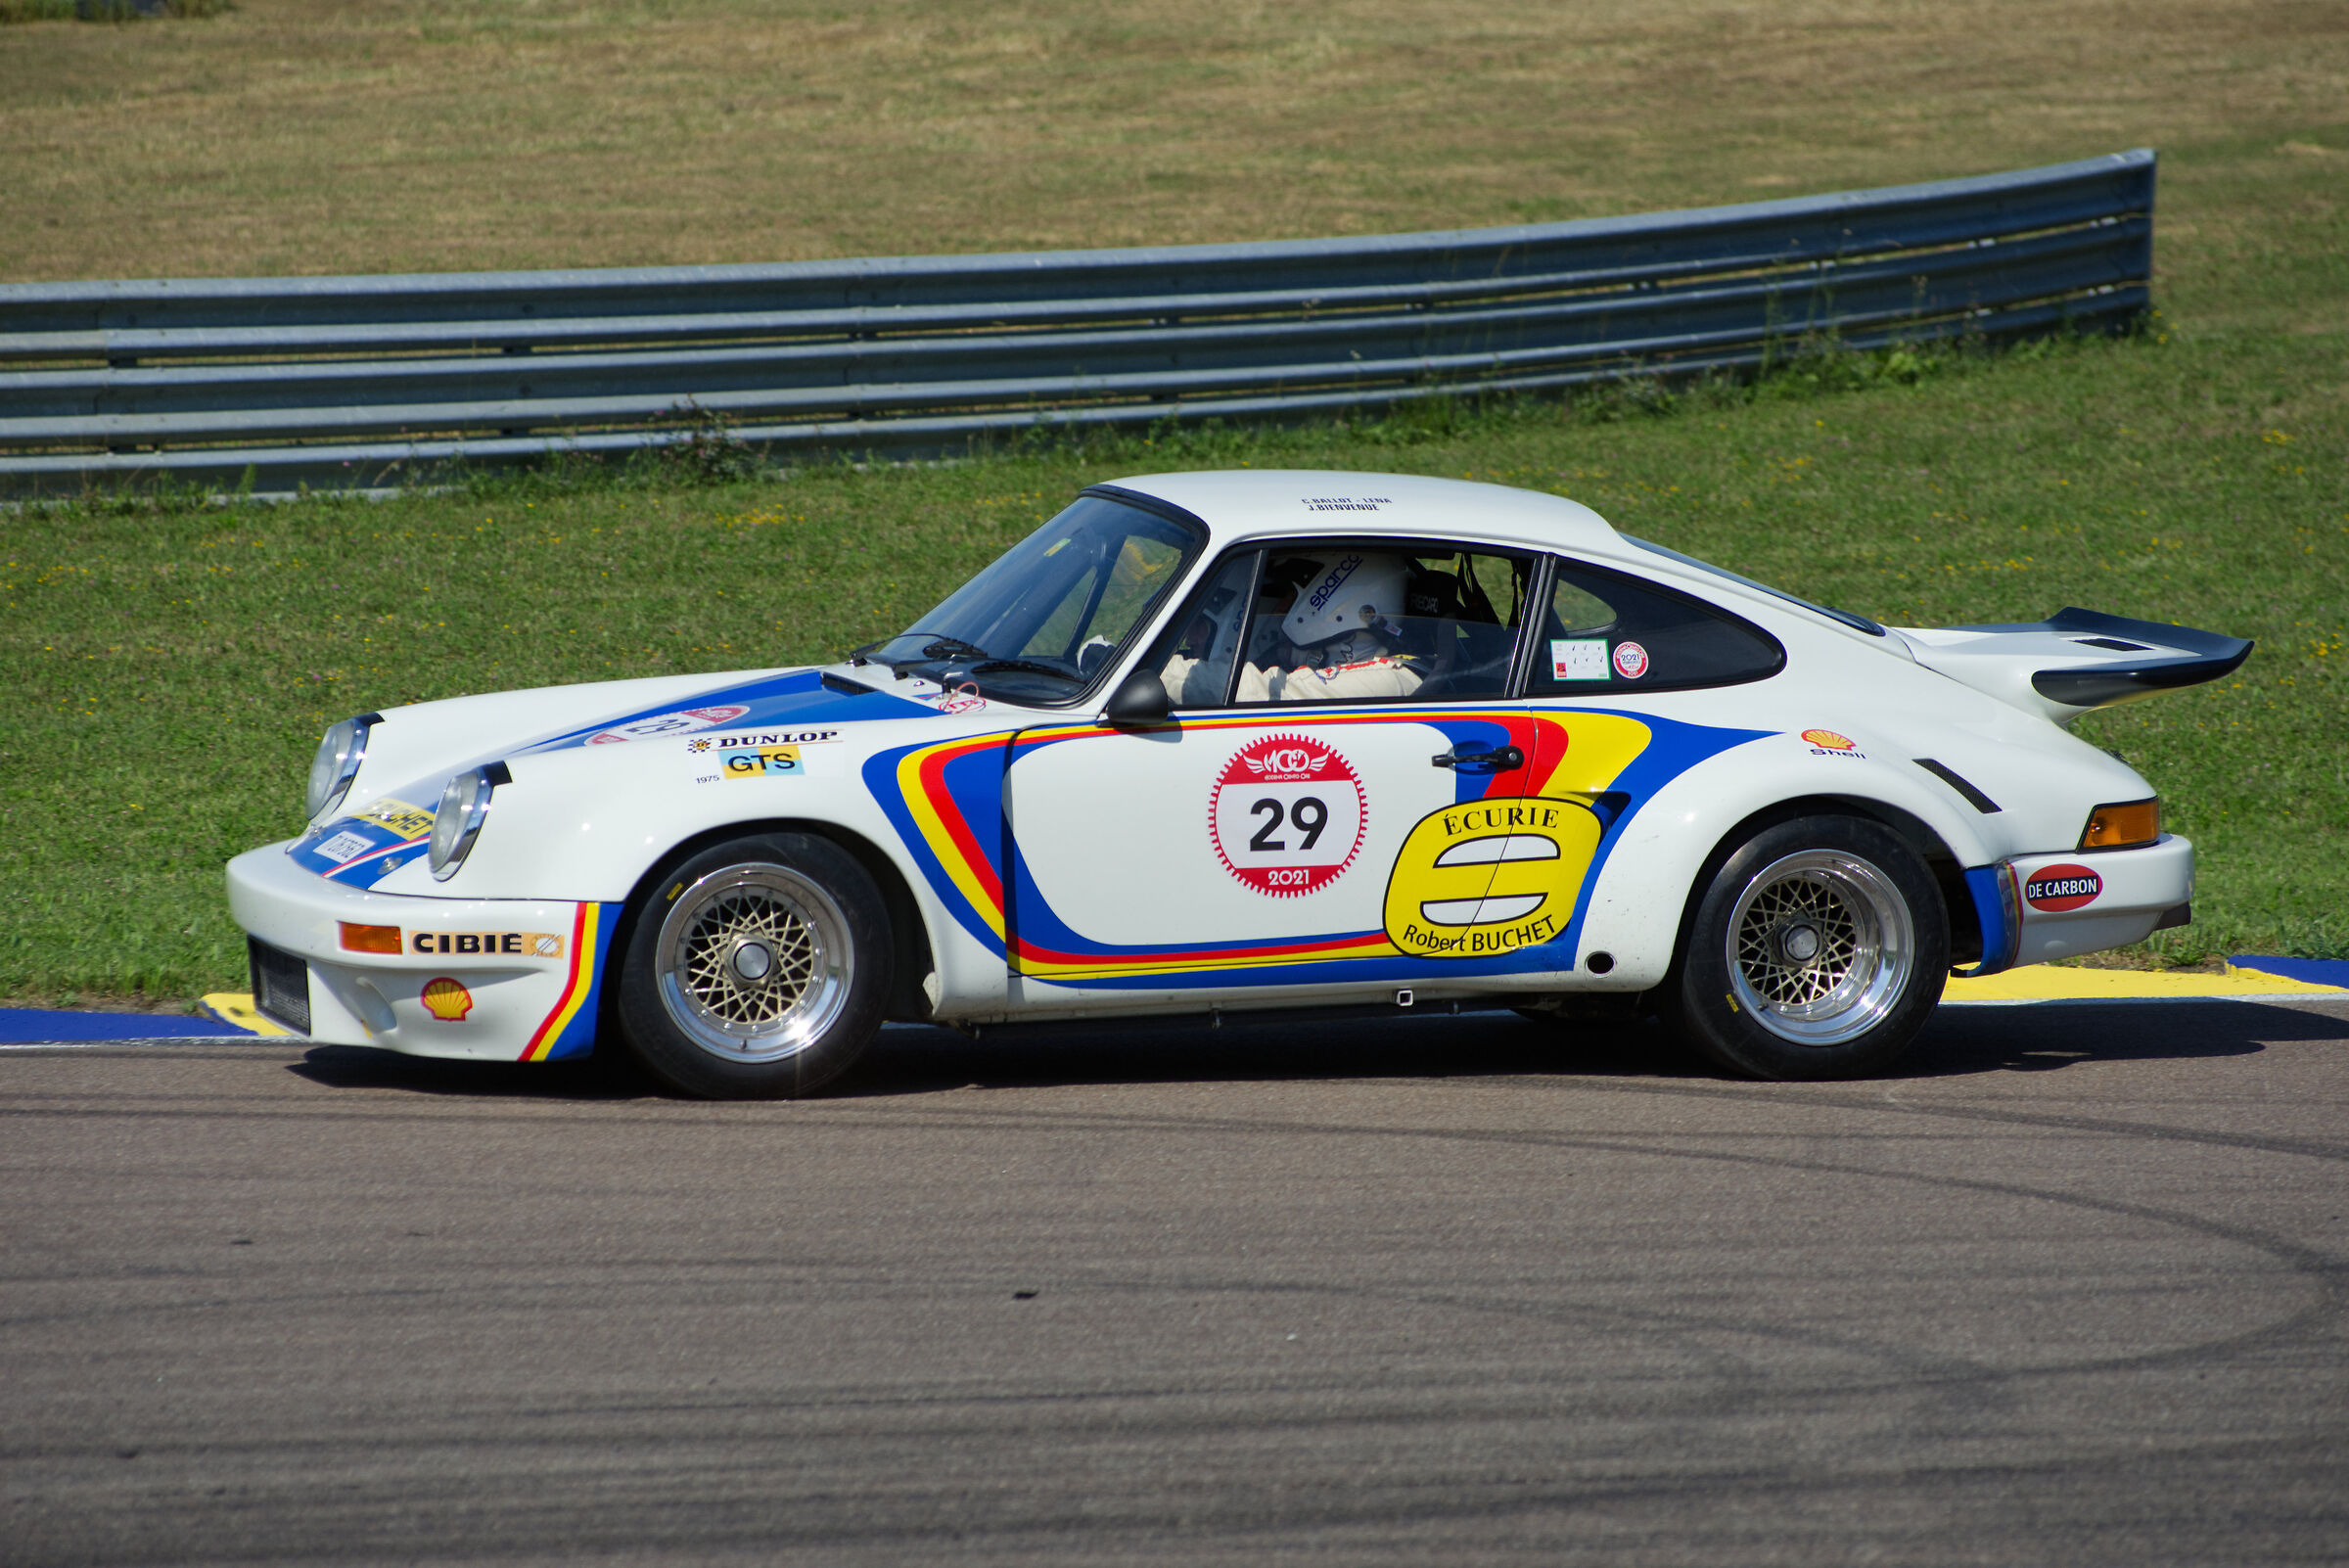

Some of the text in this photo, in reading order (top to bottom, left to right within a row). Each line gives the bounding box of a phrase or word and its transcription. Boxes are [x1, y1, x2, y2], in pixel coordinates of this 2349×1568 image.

[1310, 554, 1360, 608] sparco
[718, 731, 838, 748] DUNLOP
[727, 753, 796, 772] GTS
[1810, 749, 1865, 760] Shell
[696, 774, 720, 784] 1975
[1250, 797, 1328, 852] 29
[1442, 807, 1559, 836] ÉCURIE
[1267, 869, 1310, 886] 2021
[2028, 883, 2043, 899] DE
[2046, 878, 2097, 897] CARBON
[1403, 914, 1556, 951] Robert BUCHET
